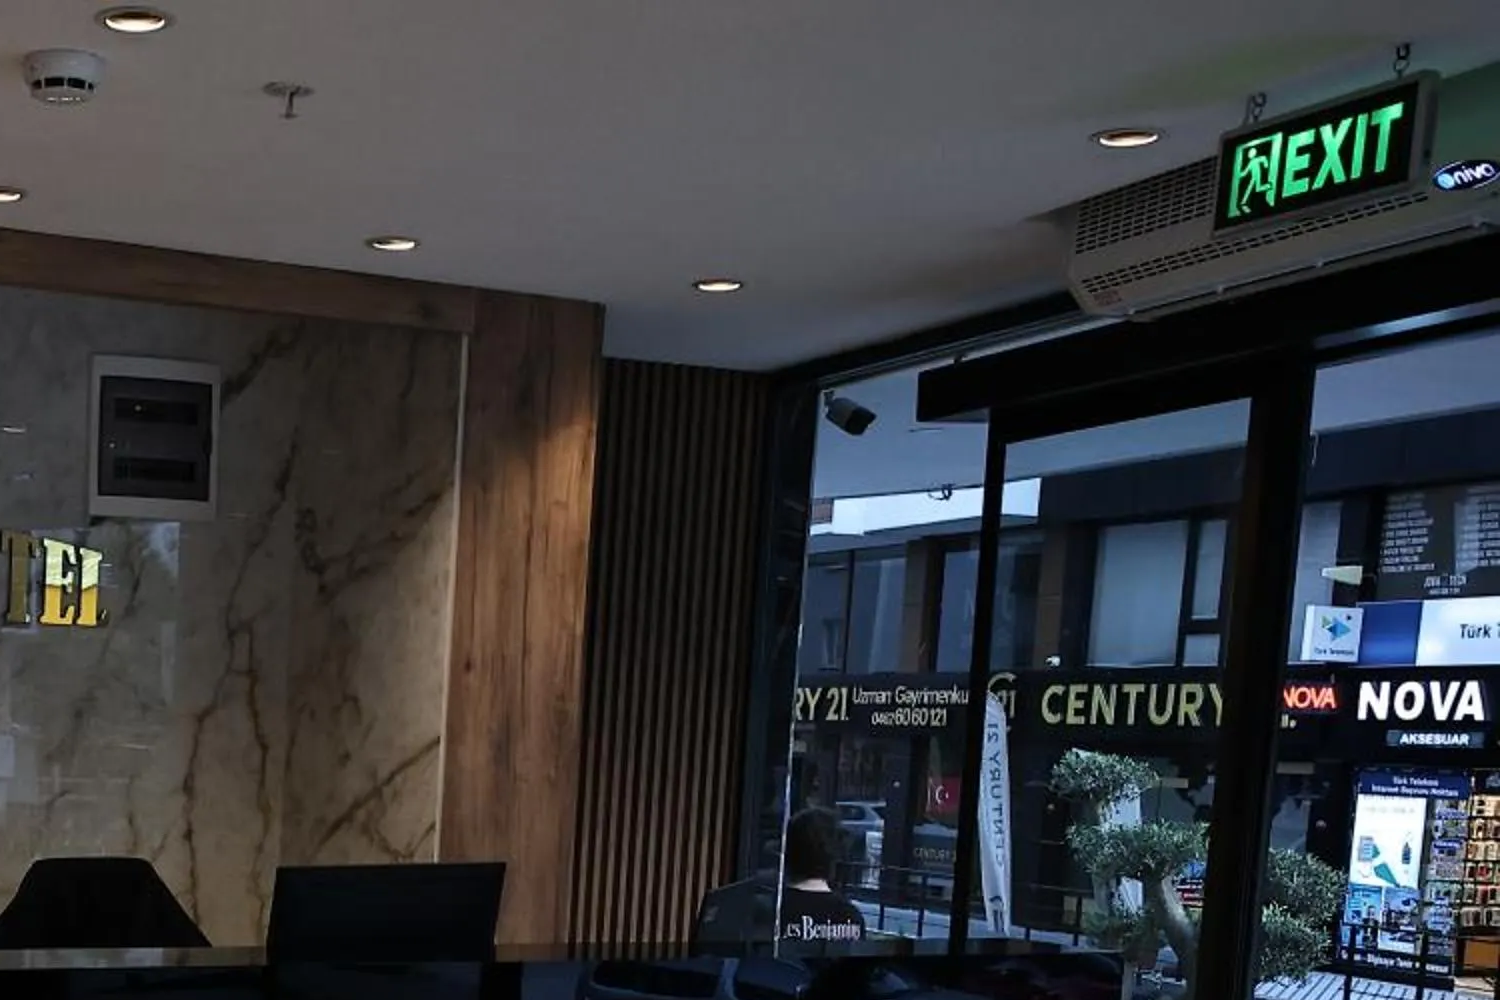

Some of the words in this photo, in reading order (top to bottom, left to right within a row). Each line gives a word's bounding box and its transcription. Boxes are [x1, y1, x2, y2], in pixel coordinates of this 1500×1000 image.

[1282, 102, 1404, 198] EXIT
[1460, 623, 1492, 640] Türk
[1041, 683, 1223, 727] CENTURY
[1283, 686, 1337, 709] NOVA
[1357, 680, 1485, 721] NOVA
[1399, 732, 1469, 746] AKSESUAR
